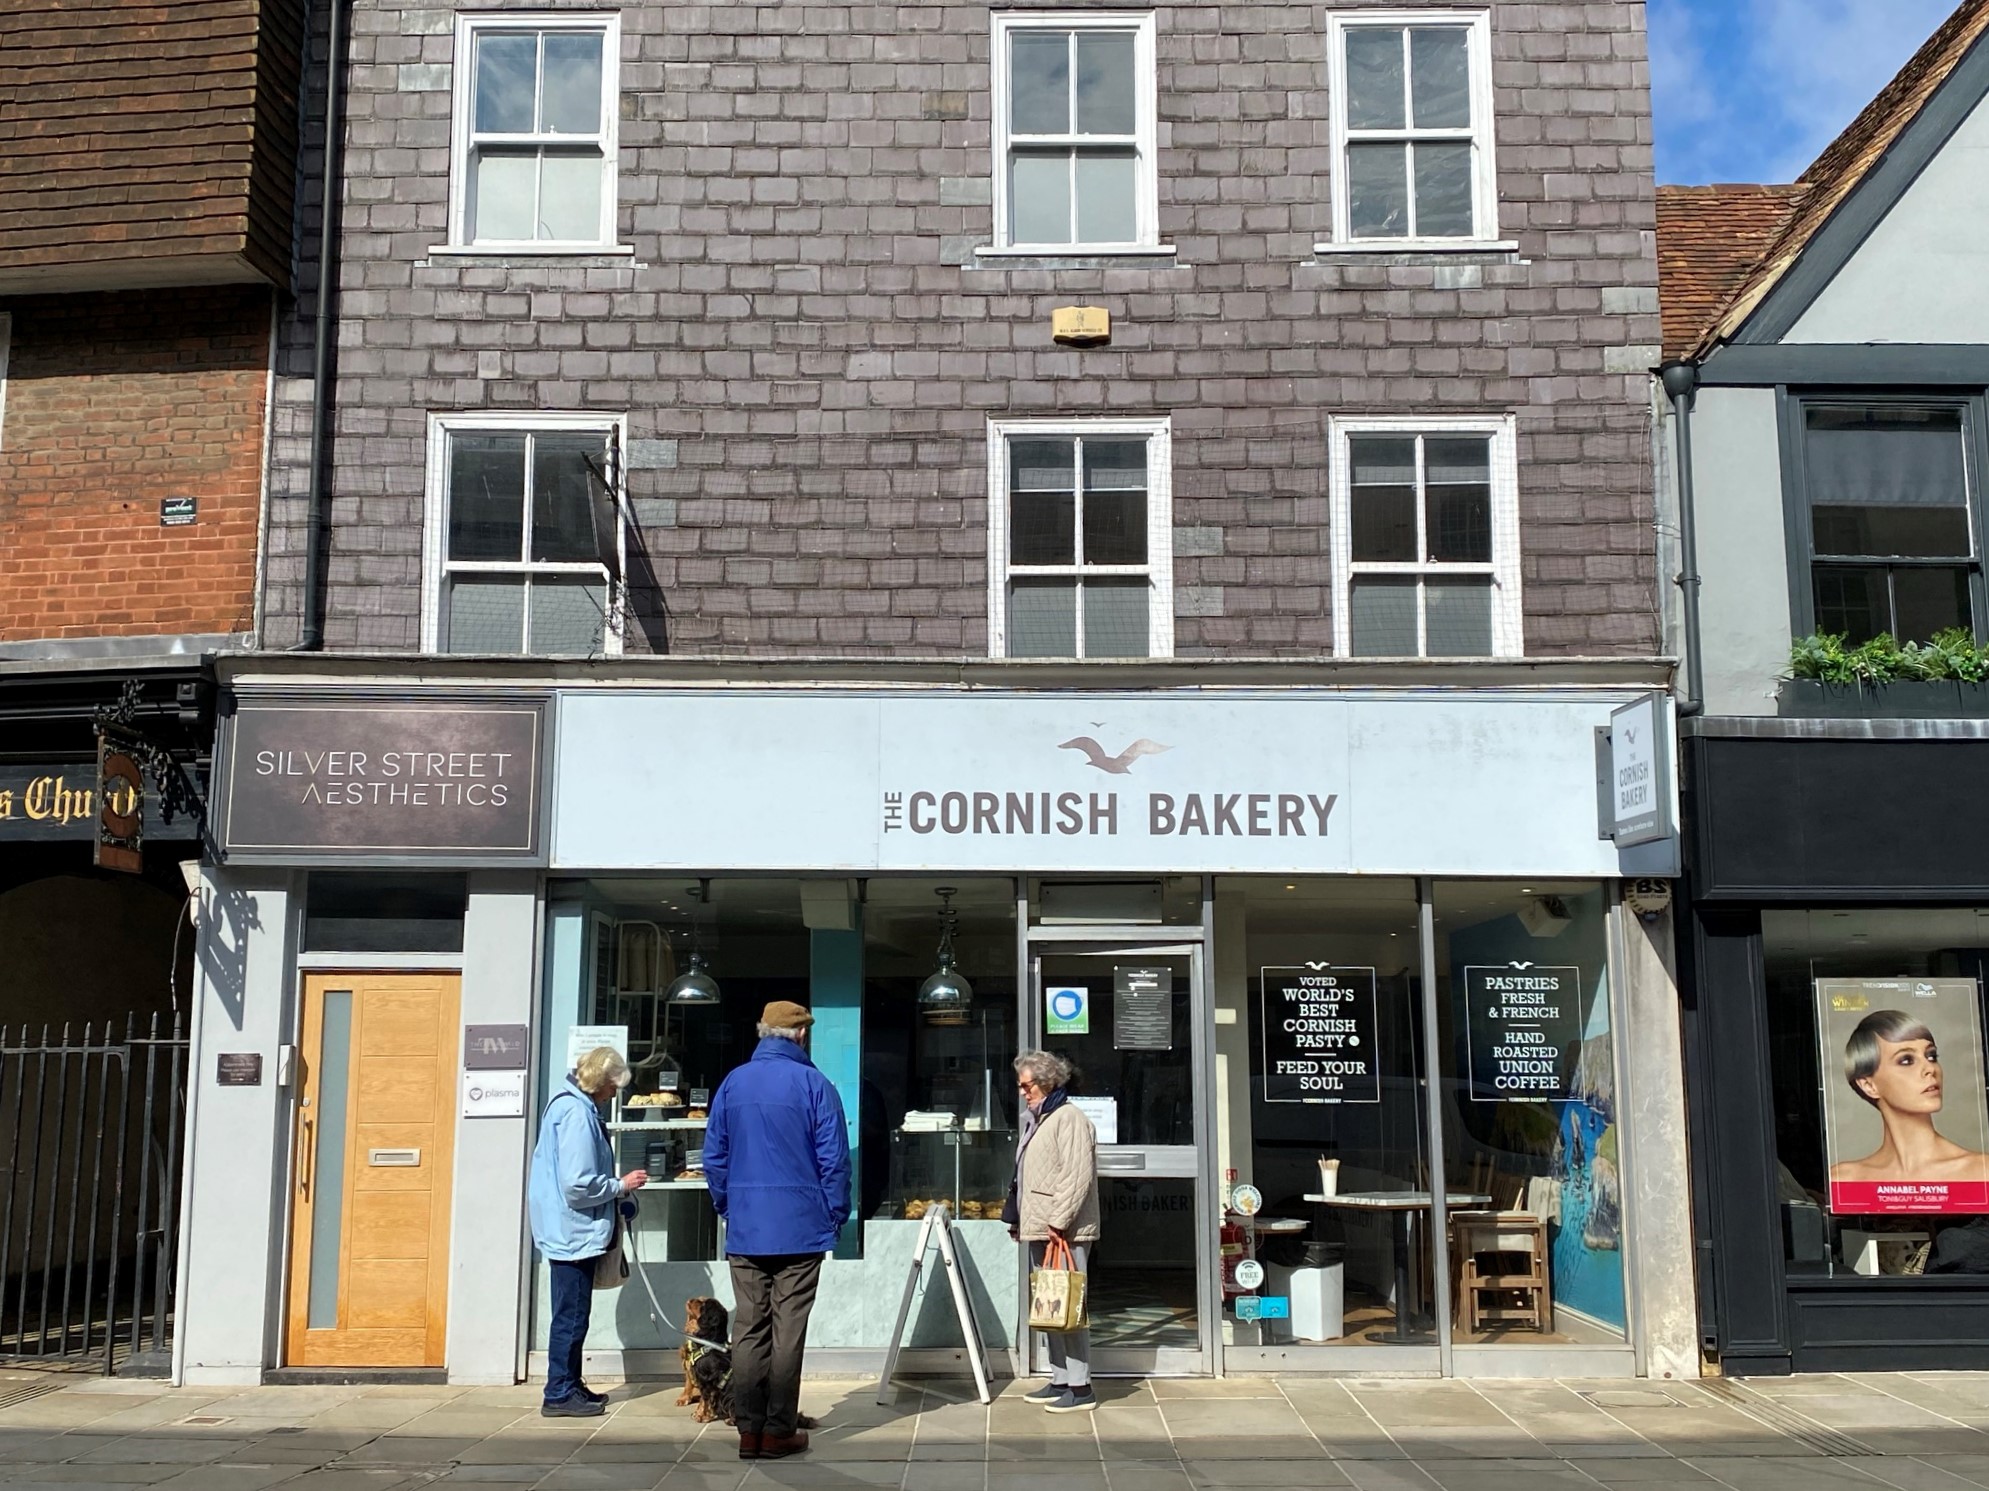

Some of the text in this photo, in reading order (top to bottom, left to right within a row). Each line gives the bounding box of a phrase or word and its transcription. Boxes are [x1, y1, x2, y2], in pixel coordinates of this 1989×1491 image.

[255, 751, 512, 778] SILVER STREET
[1619, 761, 1649, 787] CORNISH
[301, 782, 509, 807] AESTHETICS
[1621, 785, 1648, 810] BAKERY
[884, 791, 1338, 836] THE CORNISH BAKERY
[1299, 977, 1337, 987] VOTED
[1485, 977, 1559, 990] PASTRIES
[1283, 989, 1354, 1002] WORLD'S
[1501, 992, 1546, 1005] FRESH
[1299, 1004, 1339, 1017] BEST
[1488, 1007, 1560, 1019] & FRENCH
[1283, 1019, 1356, 1033] CORNISH
[1295, 1034, 1345, 1048] PASTY
[1505, 1032, 1546, 1044] HAND
[1493, 1046, 1558, 1058] ROASTED
[1276, 1061, 1367, 1074] FEED YOUR
[1499, 1060, 1554, 1074] UNION
[1299, 1076, 1344, 1090] SOUL
[1495, 1075, 1561, 1090] COFFEE
[485, 1089, 520, 1099] plasma
[1877, 1185, 1949, 1194] ANNABEL PAYNE
